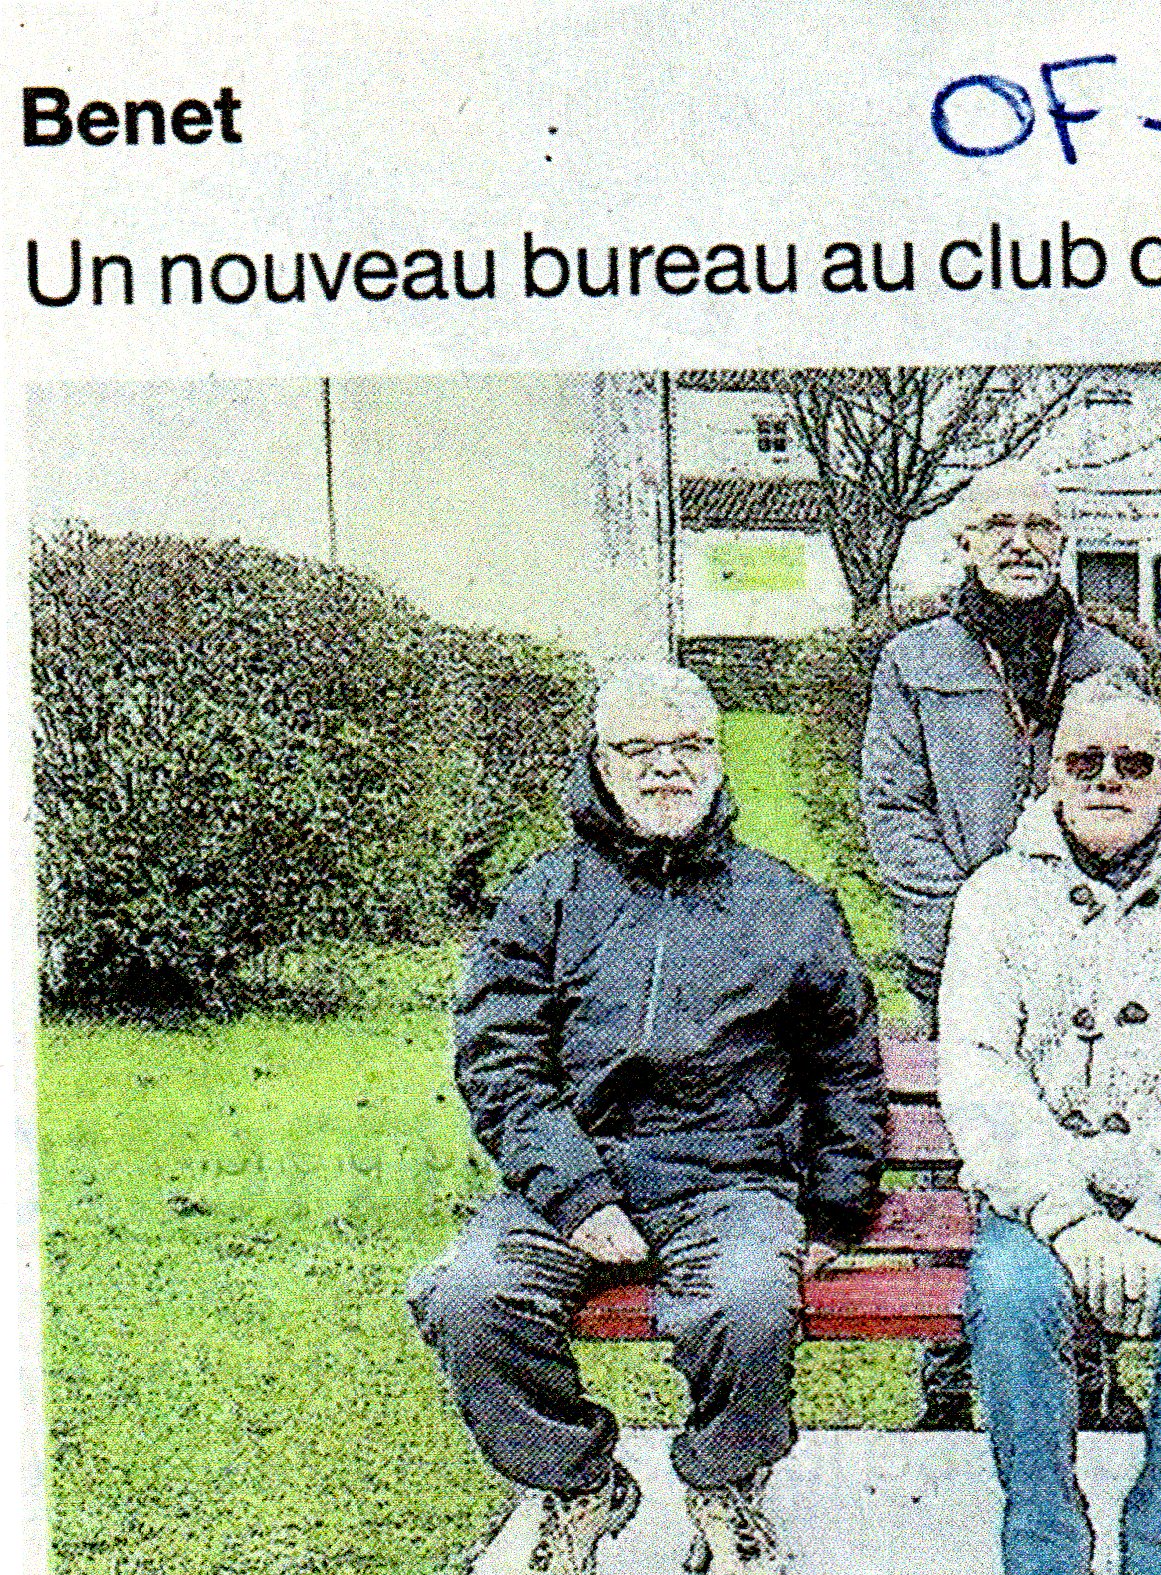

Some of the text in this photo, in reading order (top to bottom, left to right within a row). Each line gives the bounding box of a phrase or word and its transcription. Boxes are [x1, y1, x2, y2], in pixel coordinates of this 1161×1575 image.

[22, 86, 243, 148] Benet
[26, 238, 134, 308] Un
[160, 248, 496, 305] nouveau
[523, 230, 798, 299] bureau
[821, 241, 915, 294] au
[939, 220, 1108, 292] club
